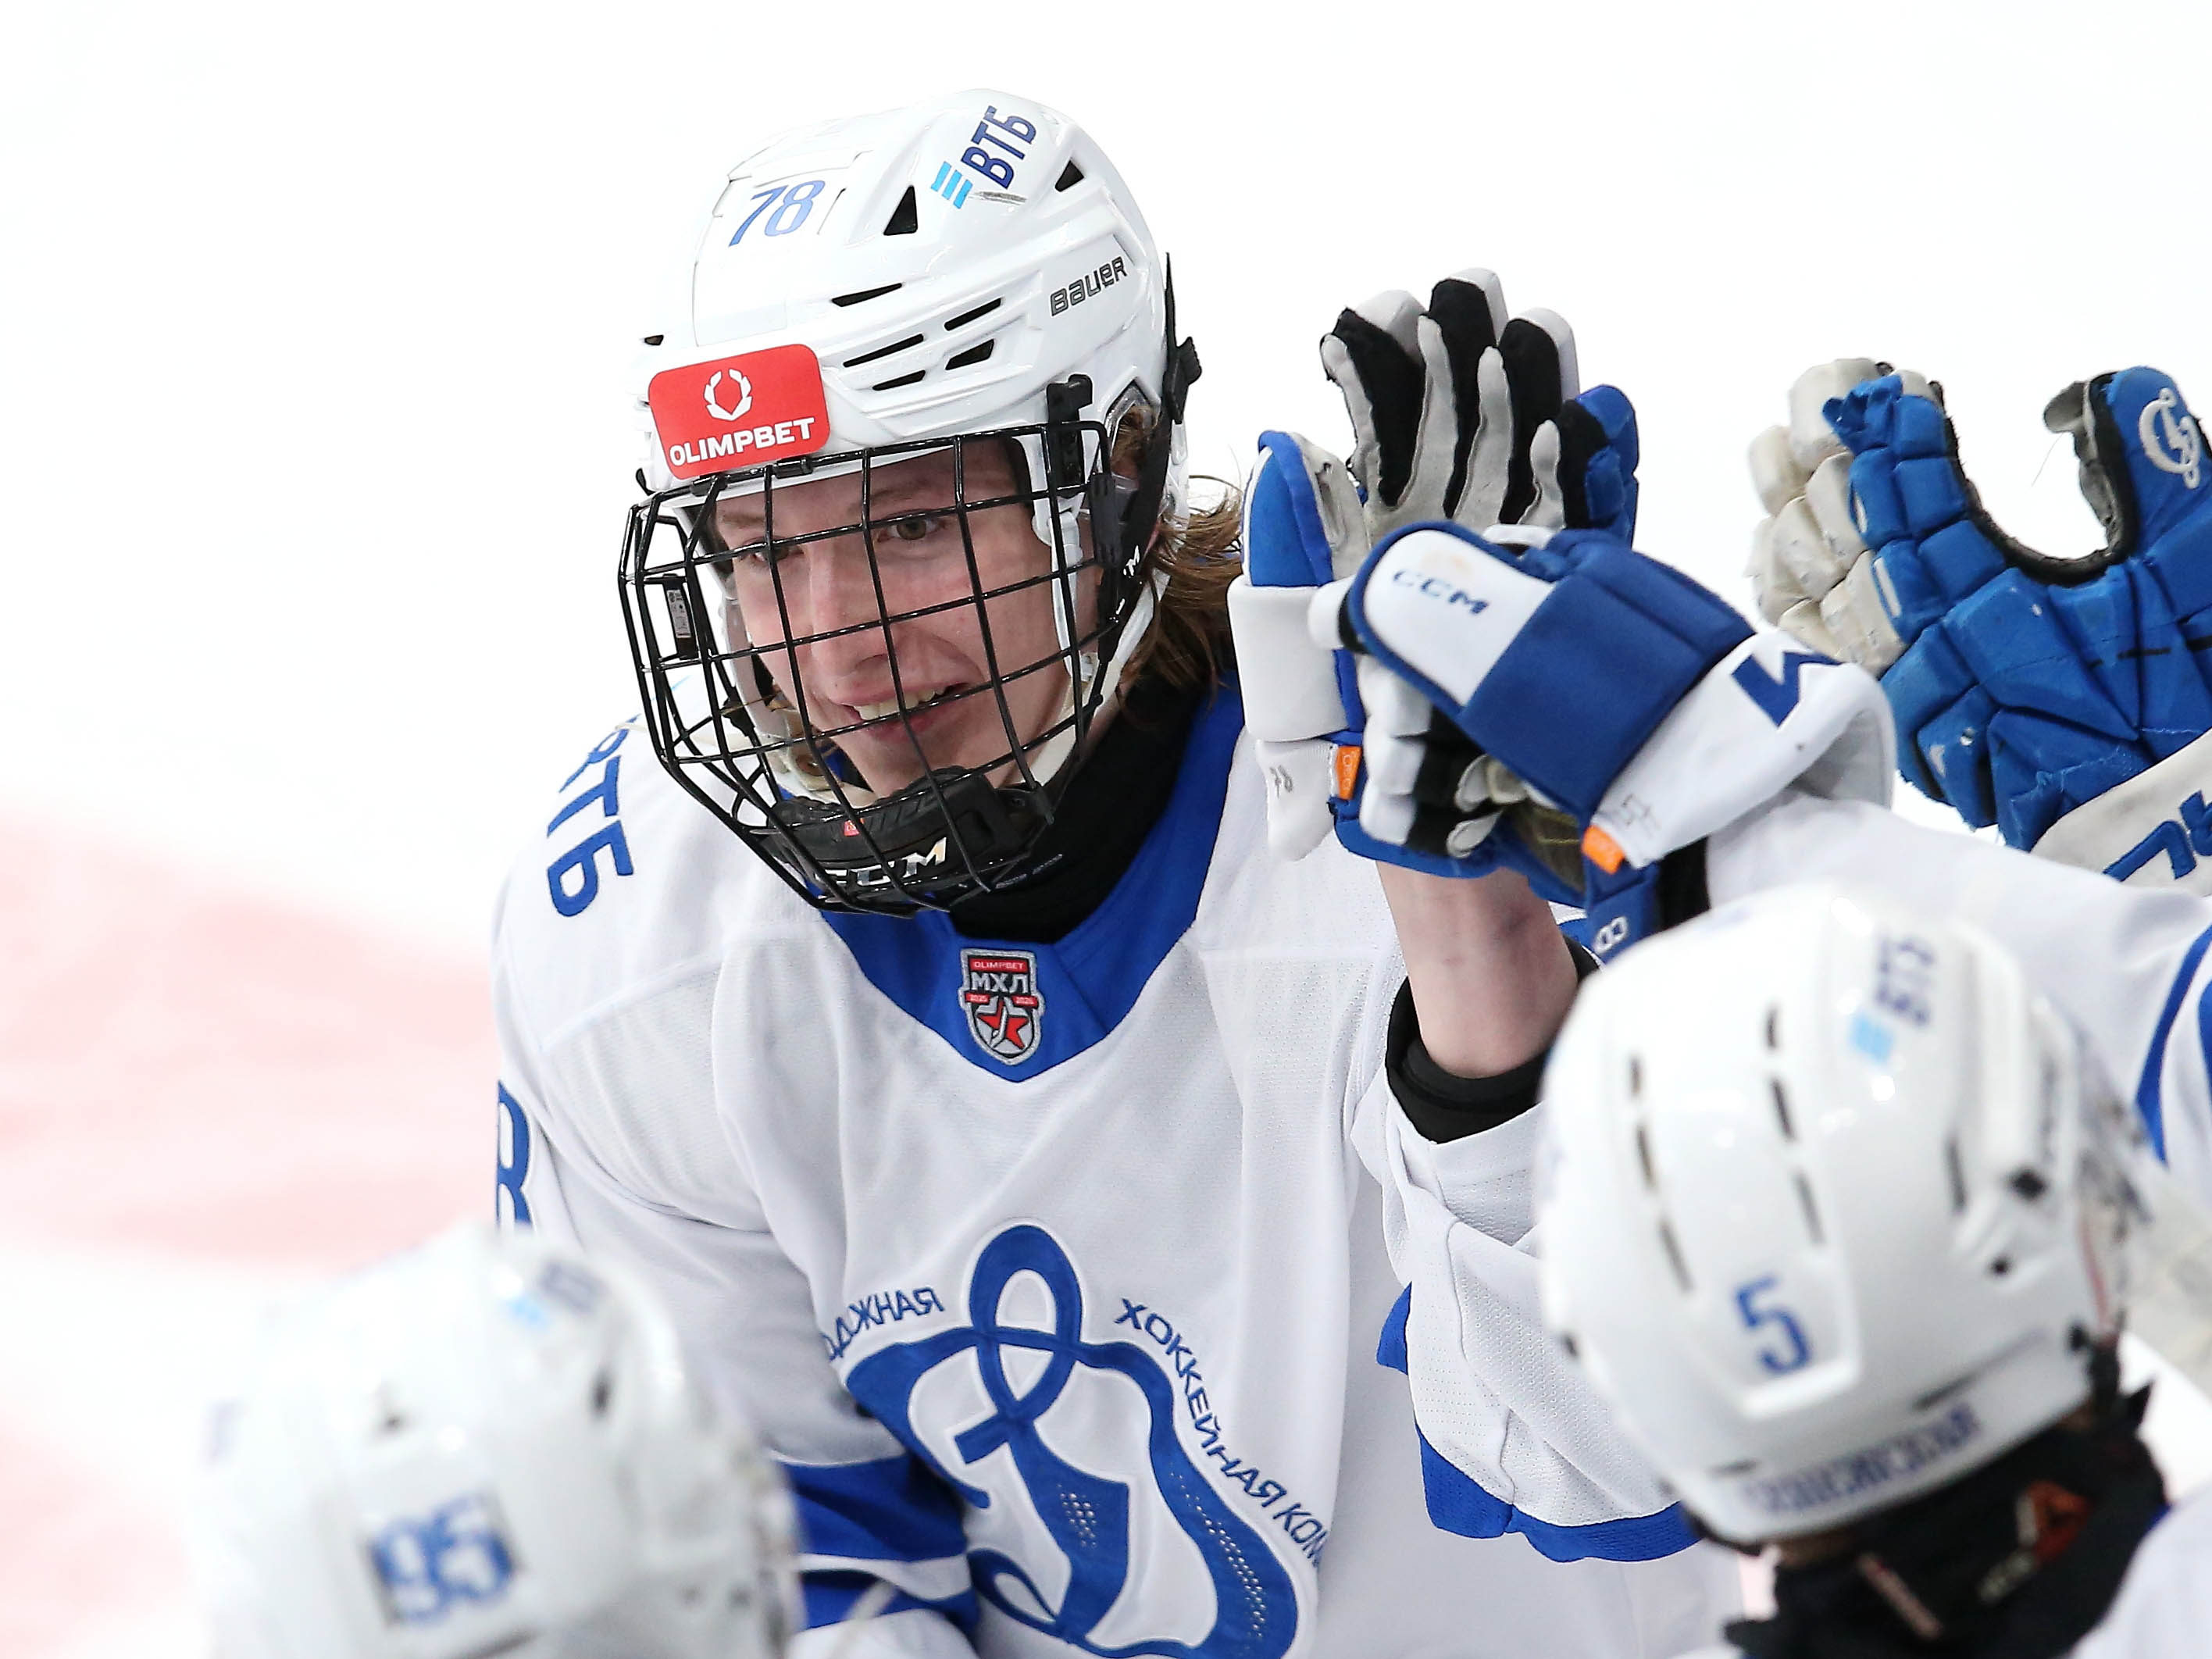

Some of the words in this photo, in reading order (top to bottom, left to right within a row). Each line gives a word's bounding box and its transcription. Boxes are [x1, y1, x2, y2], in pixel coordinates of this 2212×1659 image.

[960, 105, 1037, 189] ВТБ
[728, 180, 826, 248] 78
[669, 417, 815, 468] OLIMPBET
[1393, 569, 1489, 614] CCM
[971, 972, 1029, 994] МХЛ
[974, 961, 1024, 969] OLIMPBET
[1733, 1275, 1811, 1375] 5
[1115, 1297, 1287, 1507] ХОККЕЙНАЯ
